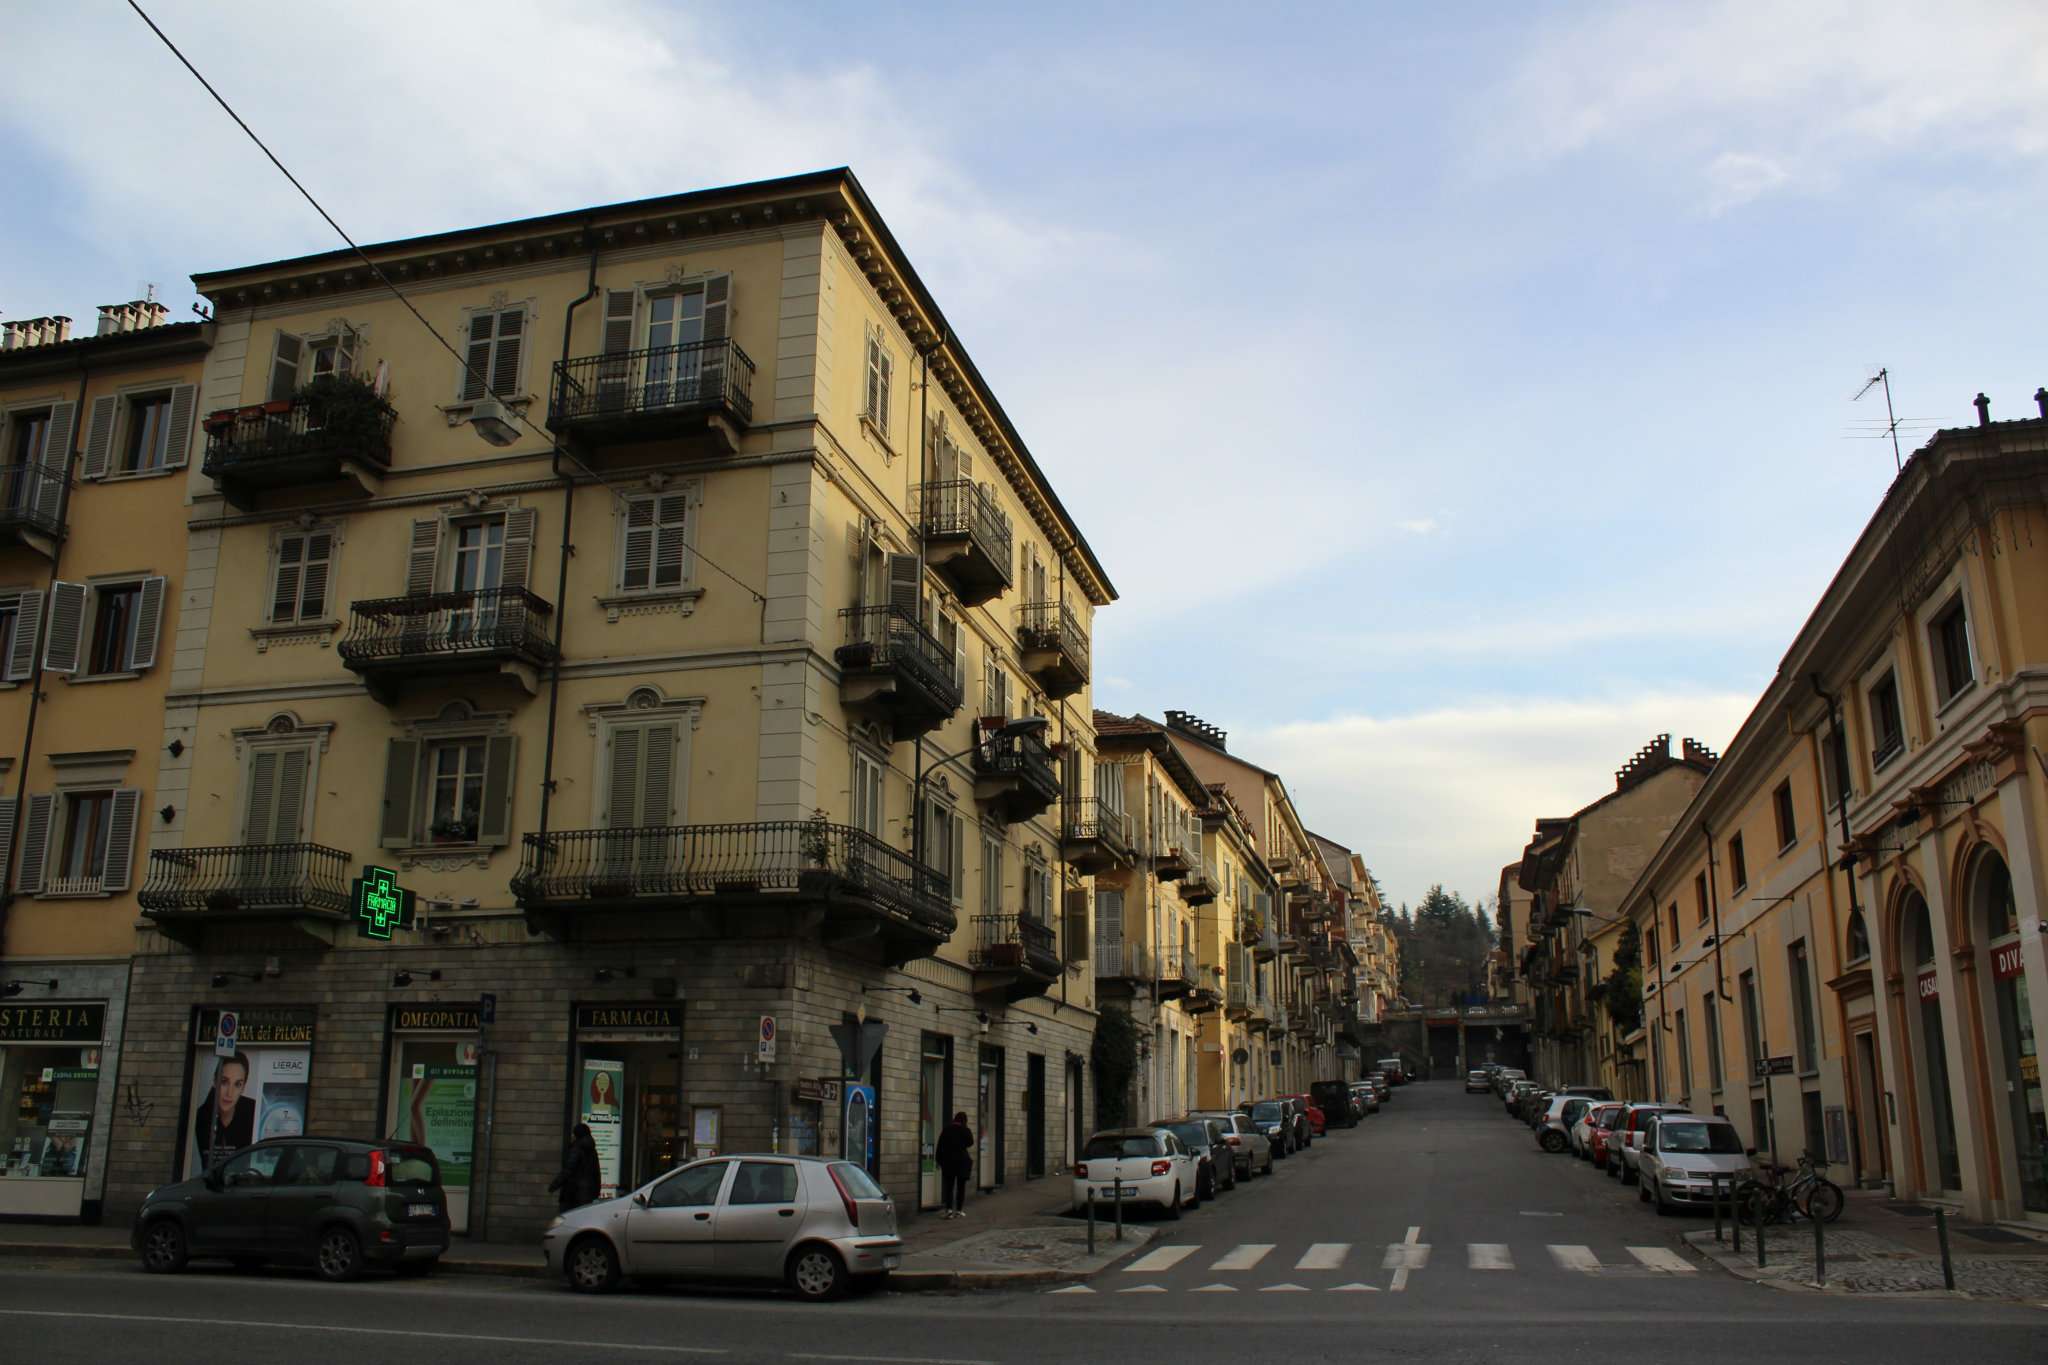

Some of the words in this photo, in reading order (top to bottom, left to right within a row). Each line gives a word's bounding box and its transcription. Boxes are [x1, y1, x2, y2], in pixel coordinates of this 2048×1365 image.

[1919, 976, 1939, 997] CASA
[0, 1008, 89, 1026] STERIA
[401, 1010, 480, 1027] OMEOPATIA
[592, 1009, 670, 1025] FARMACIA
[257, 1024, 272, 1039] del
[274, 1025, 313, 1040] PILONE
[272, 1060, 303, 1070] LIERAC
